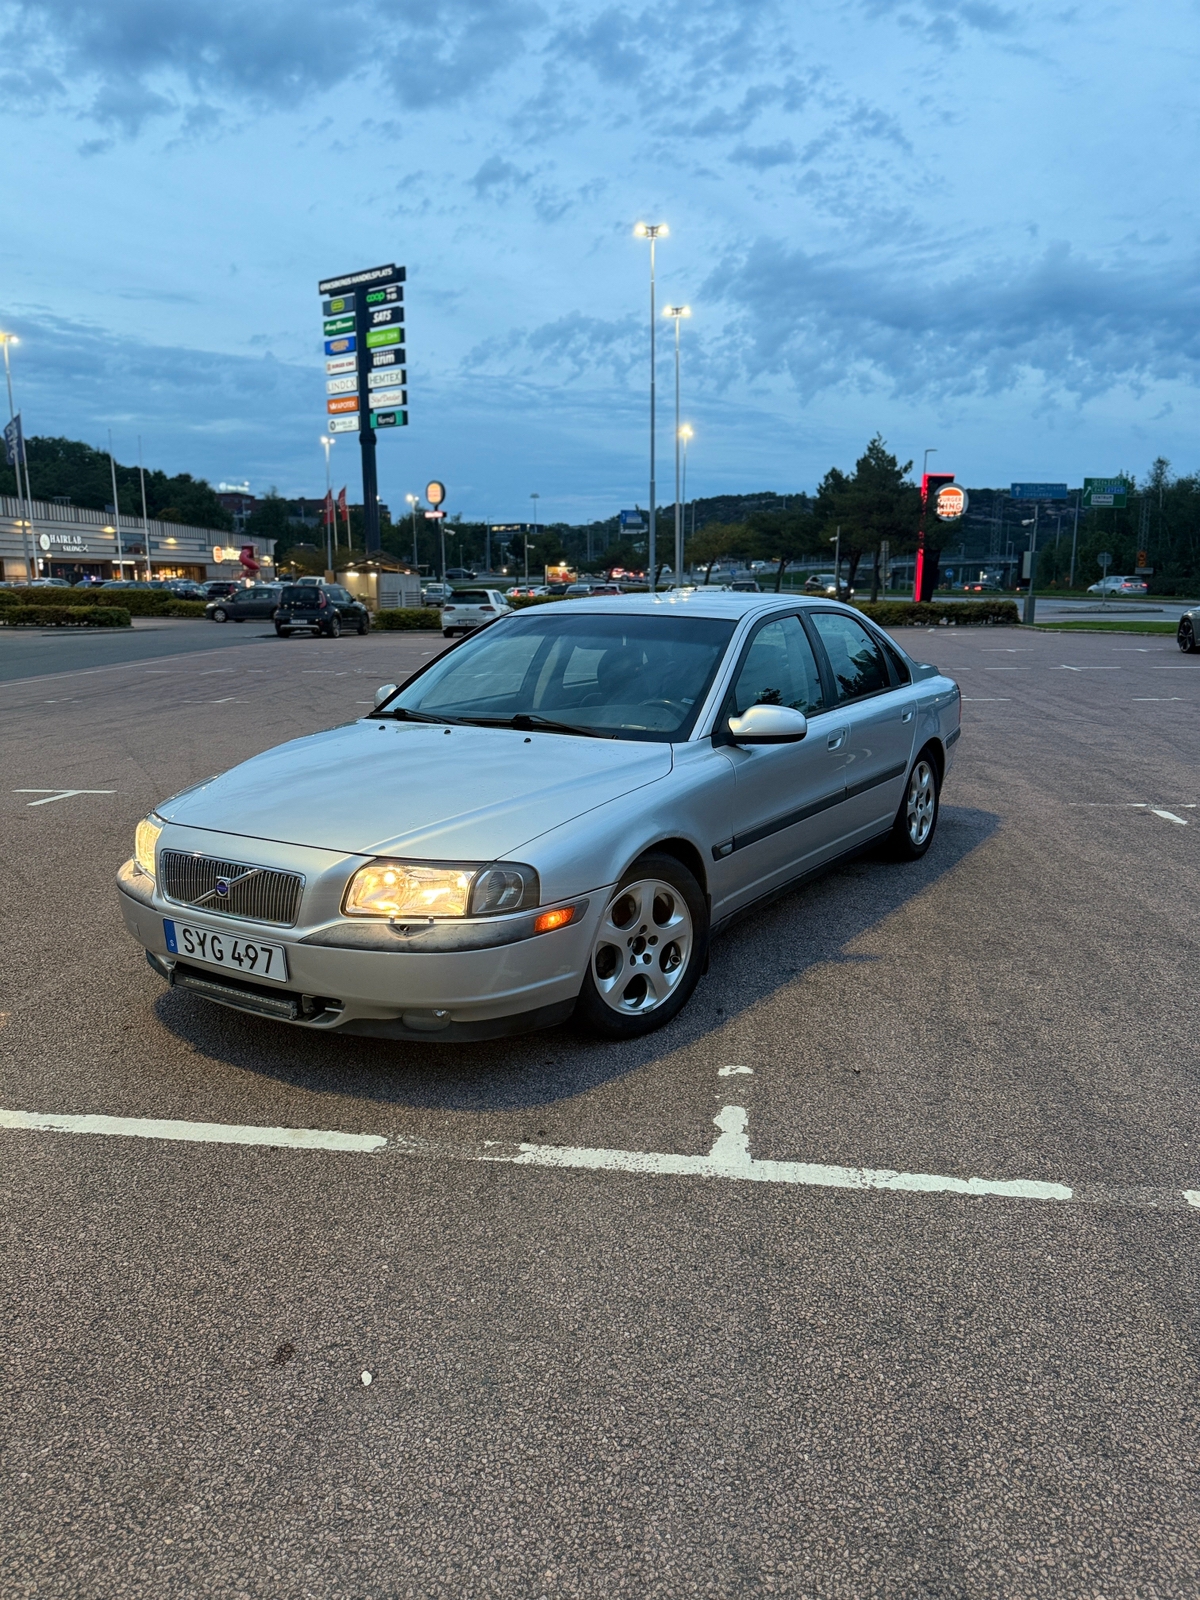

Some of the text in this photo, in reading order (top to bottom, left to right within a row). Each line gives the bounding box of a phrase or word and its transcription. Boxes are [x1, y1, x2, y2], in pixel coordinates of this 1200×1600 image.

[366, 291, 385, 303] coop
[373, 309, 392, 324] SATS
[327, 378, 356, 392] LINDEX
[369, 372, 400, 385] HEMTEX
[50, 534, 82, 544] HAIRLAB
[182, 927, 274, 974] SYG 497
